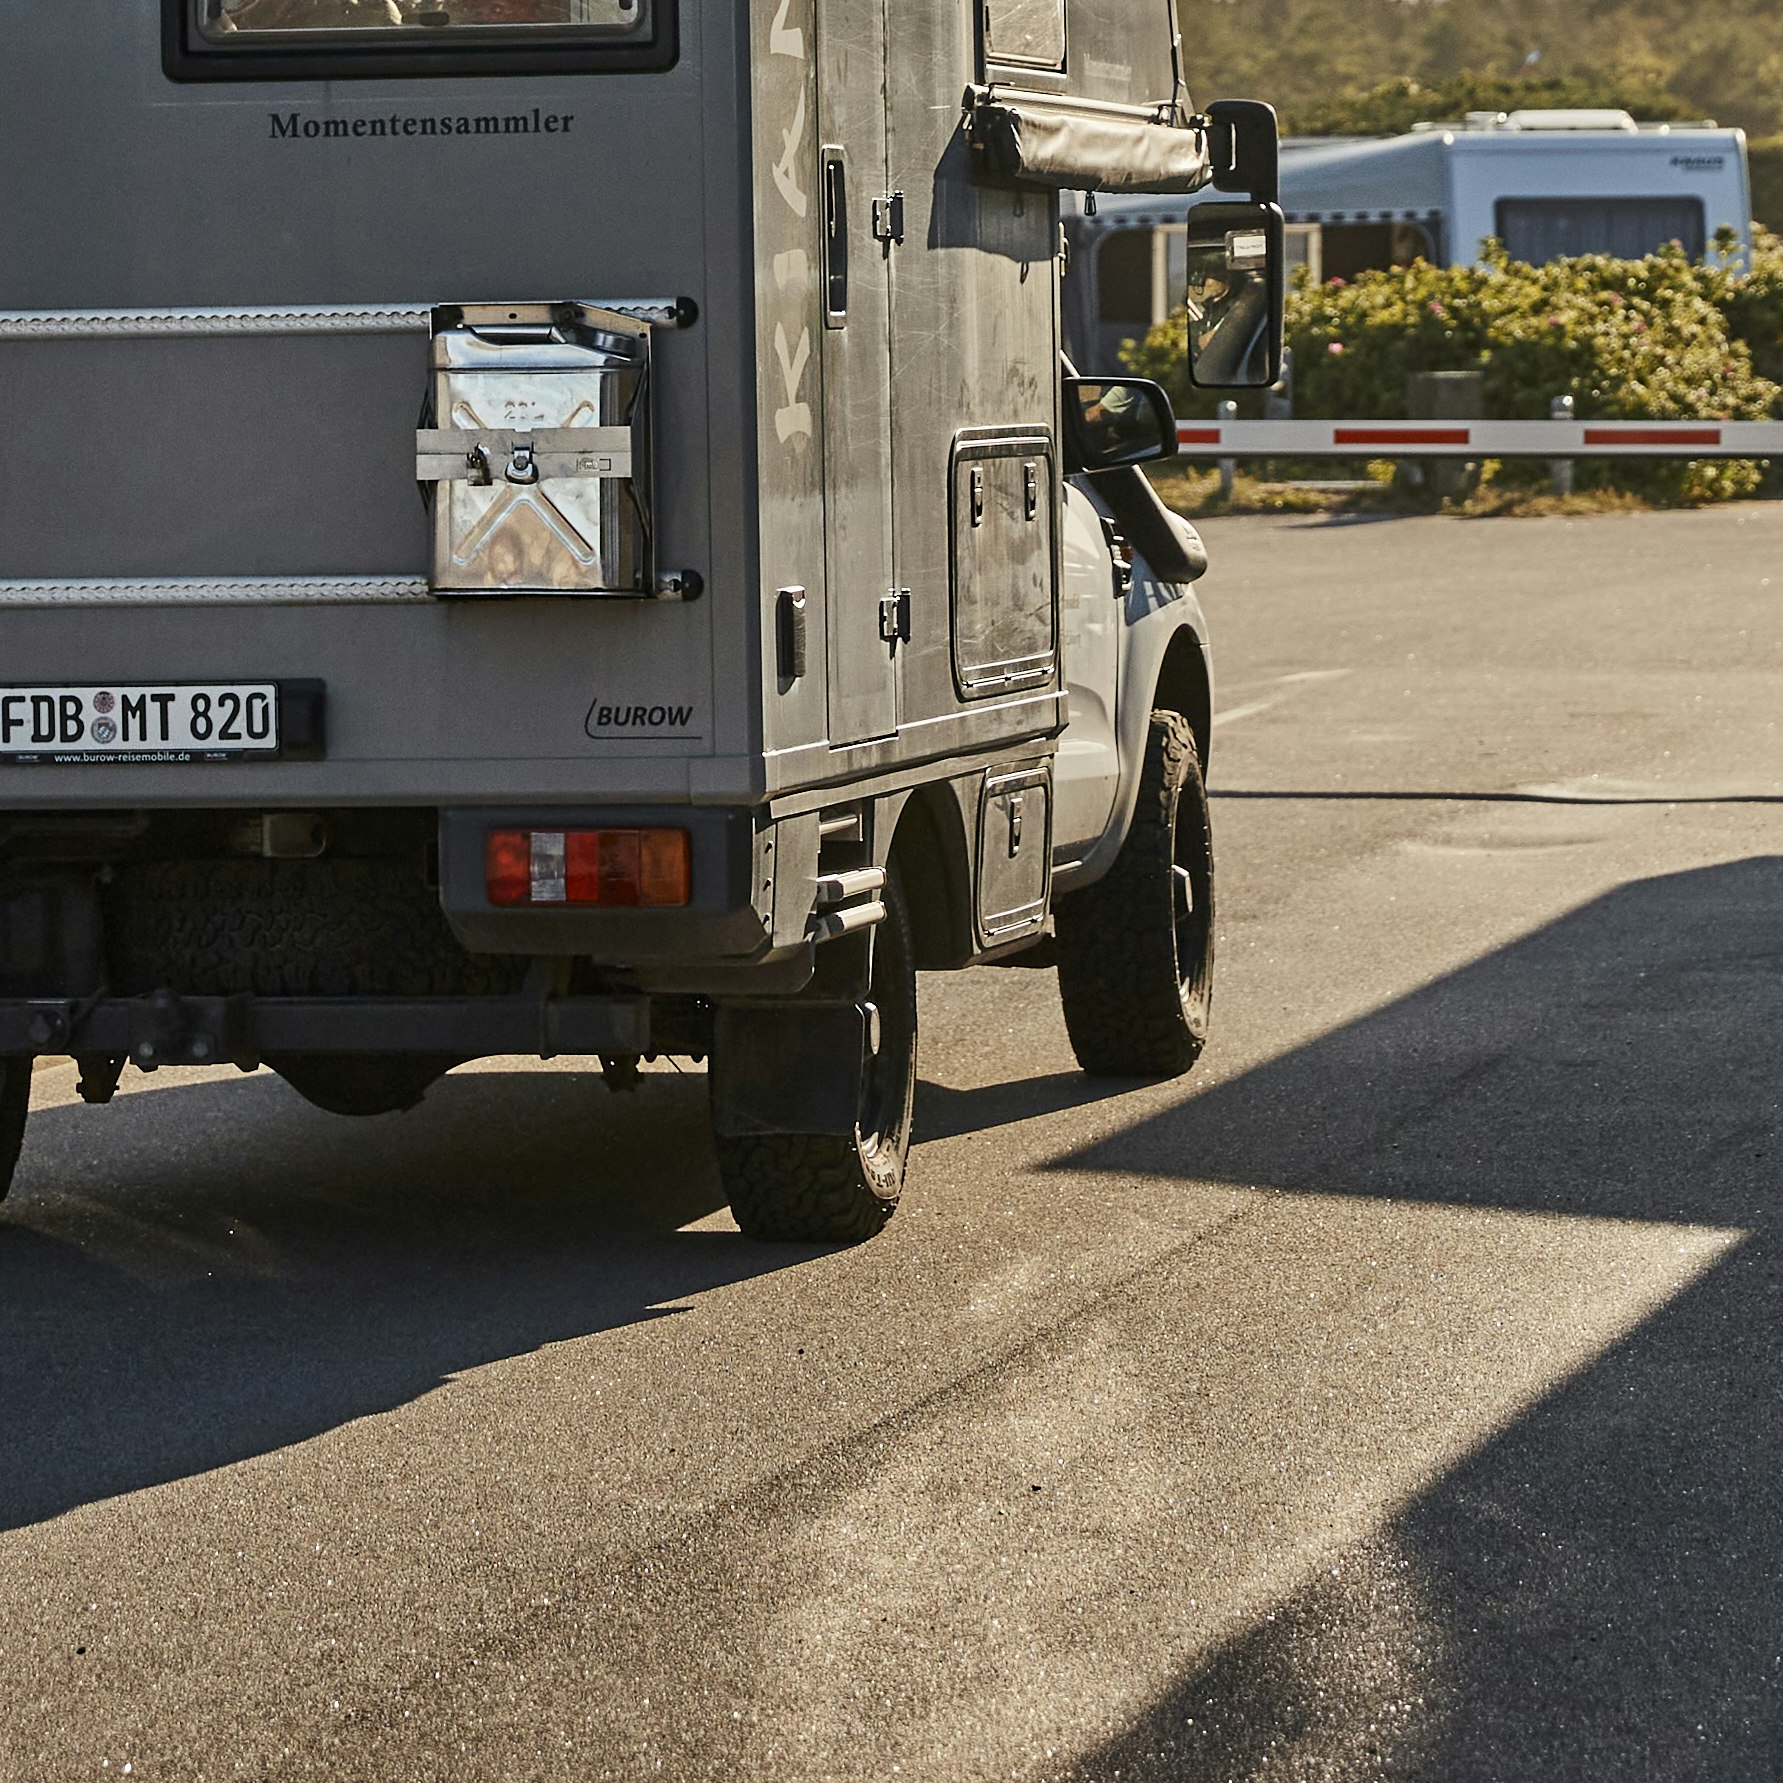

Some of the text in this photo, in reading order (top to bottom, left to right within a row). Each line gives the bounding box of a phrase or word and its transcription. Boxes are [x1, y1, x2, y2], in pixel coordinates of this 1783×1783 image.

[267, 108, 574, 139] Momentensammler
[1, 695, 85, 744] FDB
[121, 693, 176, 742] MT
[189, 692, 270, 741] 820
[596, 706, 694, 727] BUROW
[54, 751, 191, 763] www.burow-reisemobile.de
